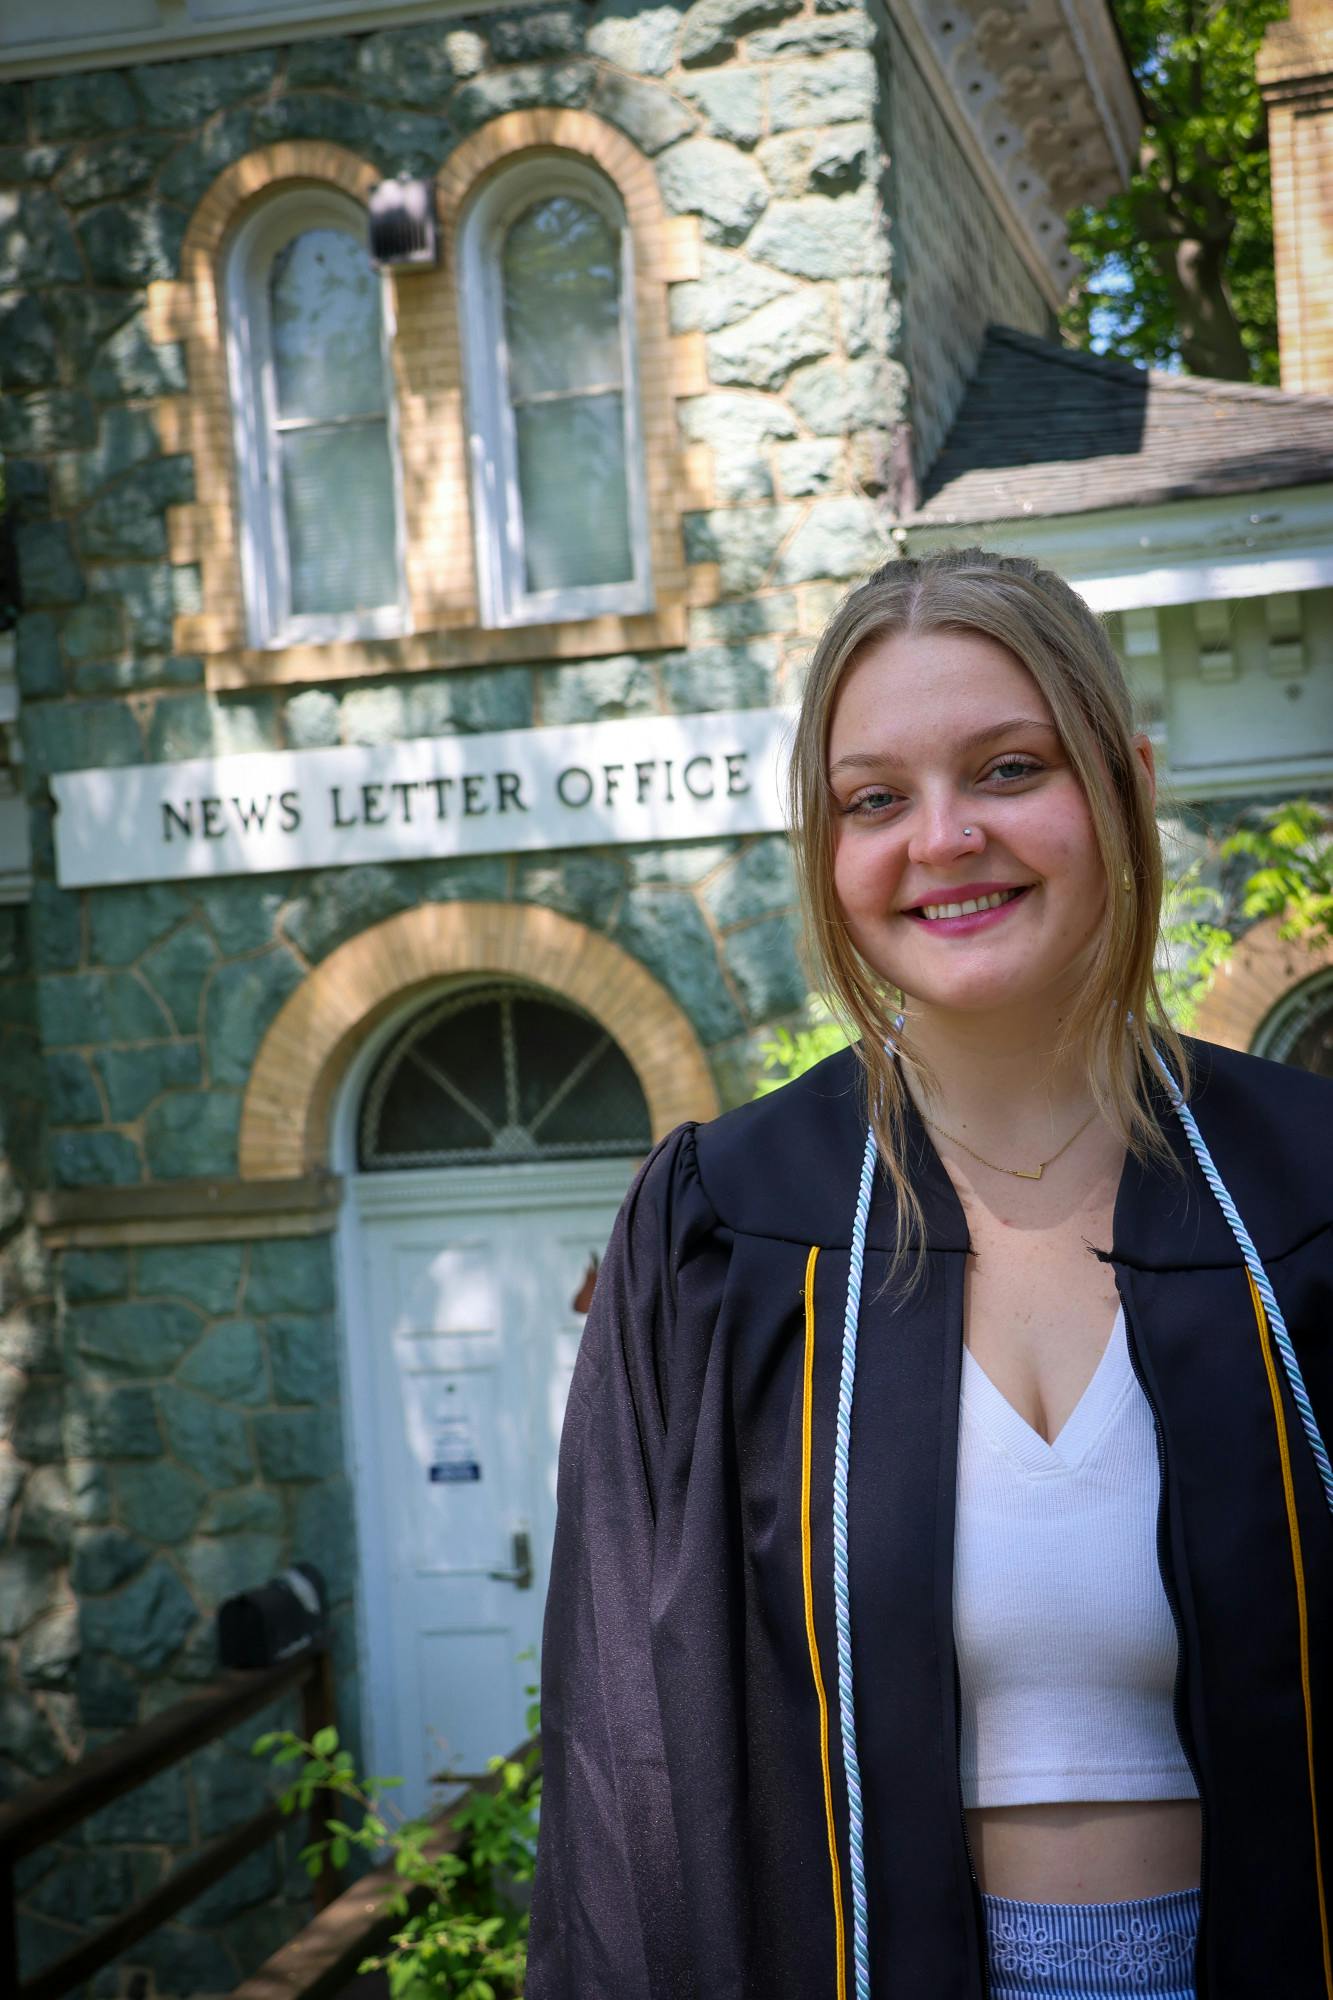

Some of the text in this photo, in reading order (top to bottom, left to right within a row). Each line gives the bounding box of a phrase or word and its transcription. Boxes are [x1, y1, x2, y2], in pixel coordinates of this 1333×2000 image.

[162, 753, 751, 843] NEWS LETTER OFFICE
